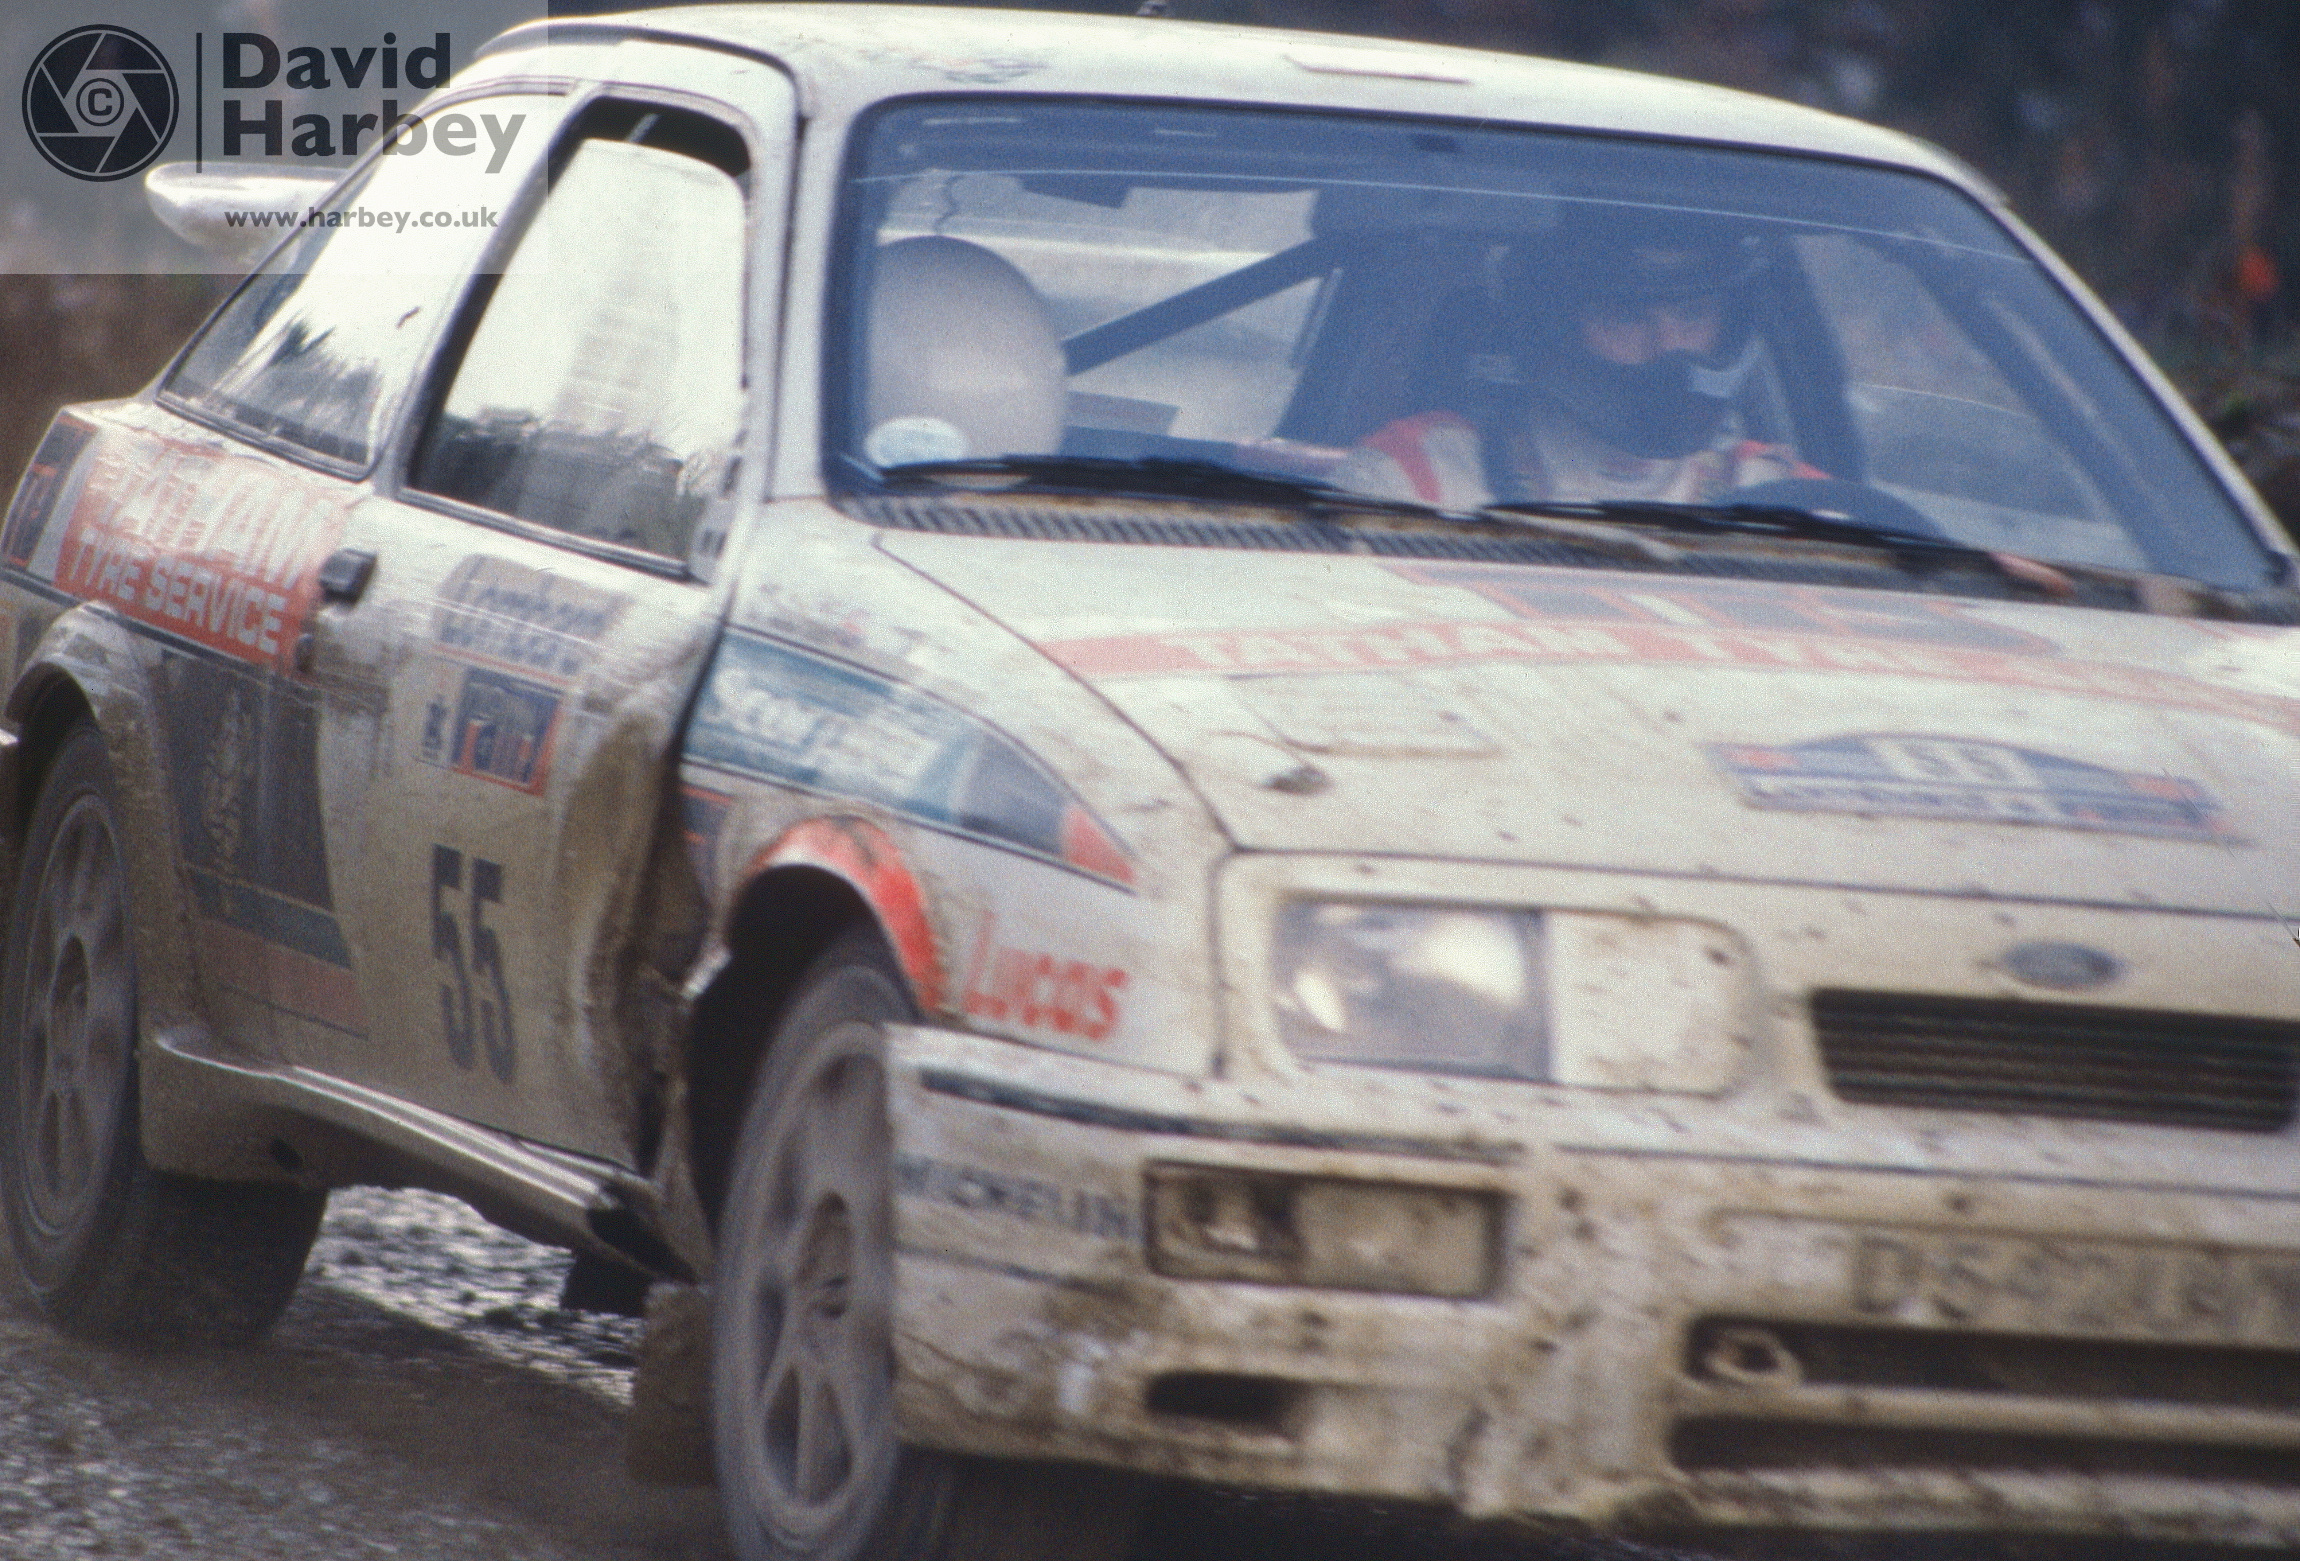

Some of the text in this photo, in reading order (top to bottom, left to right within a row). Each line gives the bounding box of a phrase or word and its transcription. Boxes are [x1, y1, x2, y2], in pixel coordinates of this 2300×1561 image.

[69, 526, 288, 657] TYRE SERVICE
[1163, 622, 1633, 669] TATHAM
[431, 843, 519, 1085] 55
